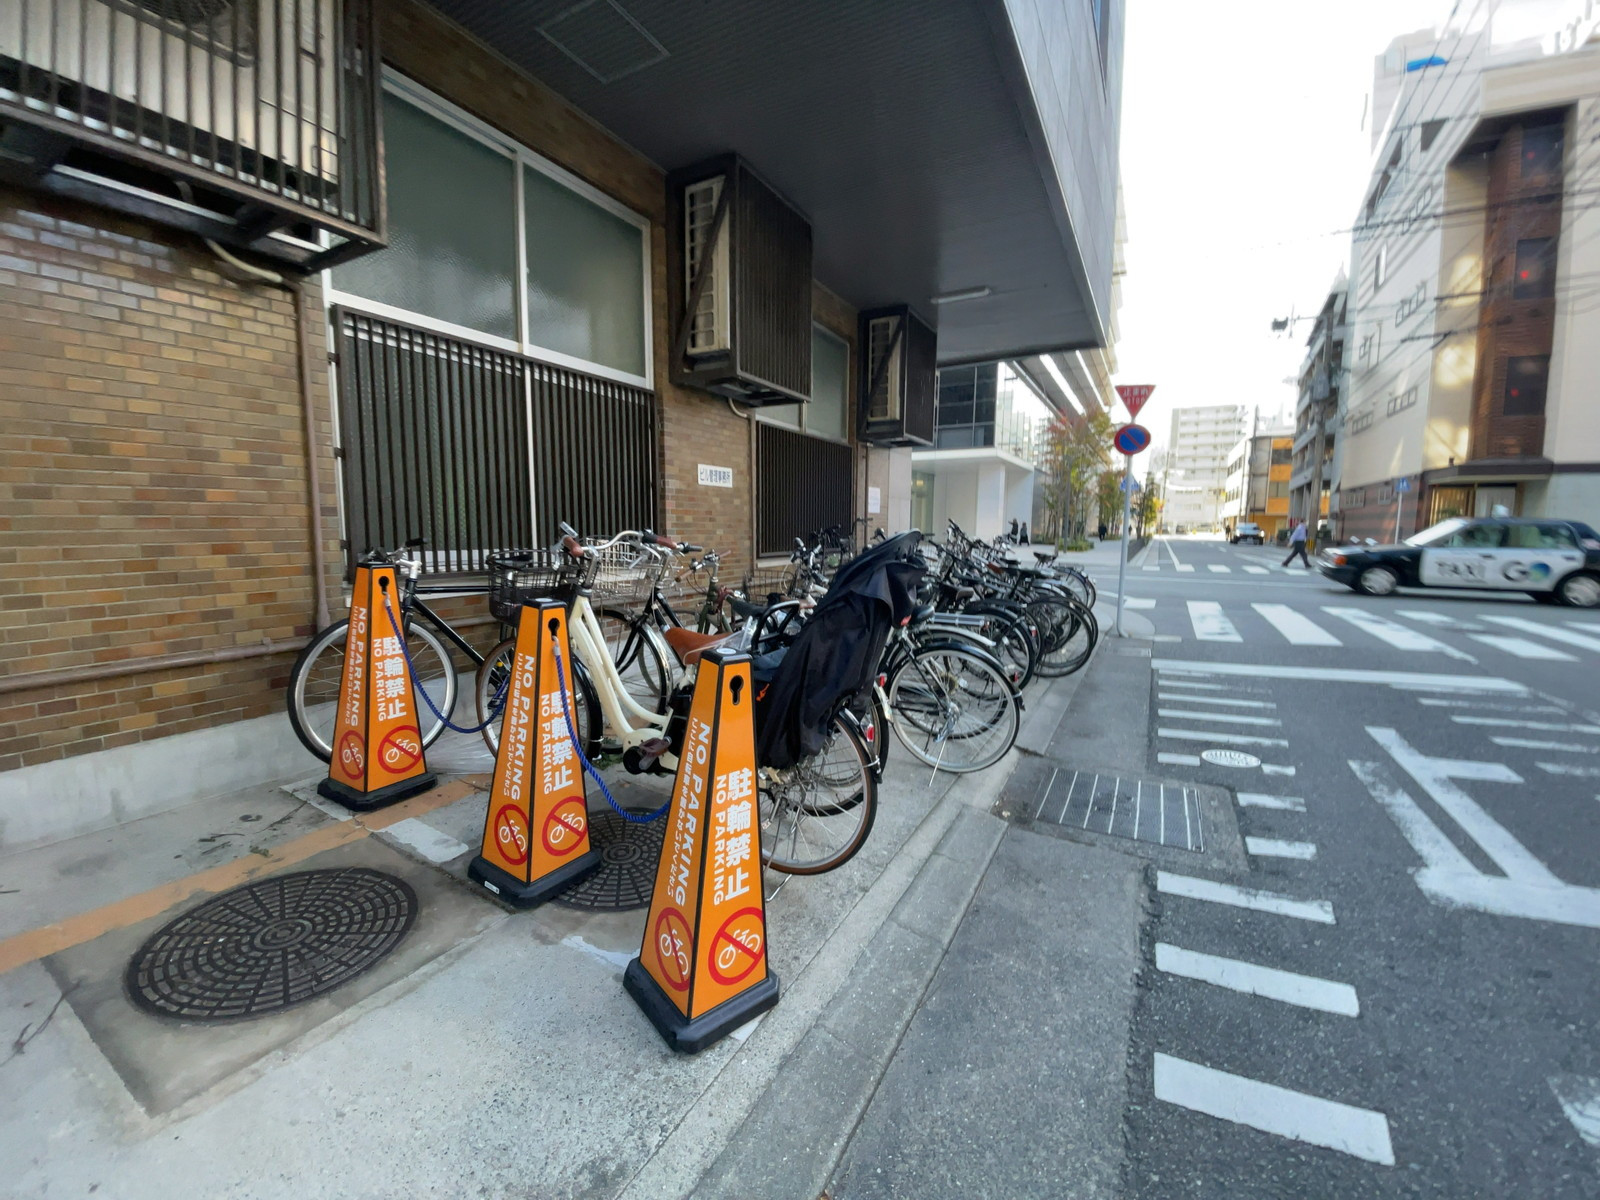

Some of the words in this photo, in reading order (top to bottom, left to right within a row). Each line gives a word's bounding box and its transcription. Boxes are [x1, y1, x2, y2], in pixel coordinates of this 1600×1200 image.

[357, 607, 367, 634] NO
[373, 638, 382, 658] NO
[350, 641, 364, 726] PARKING
[375, 662, 387, 722] PARKING
[382, 635, 407, 719] 駐輪禁止
[522, 655, 535, 688] NO
[541, 694, 550, 717] NO
[511, 695, 530, 801] PARKING
[541, 723, 552, 795] PARKING
[696, 722, 711, 765] NO
[715, 774, 727, 804] NO
[675, 773, 703, 907] PARKING
[713, 810, 726, 906] PARKING
[724, 767, 752, 901] 駐輪禁止
